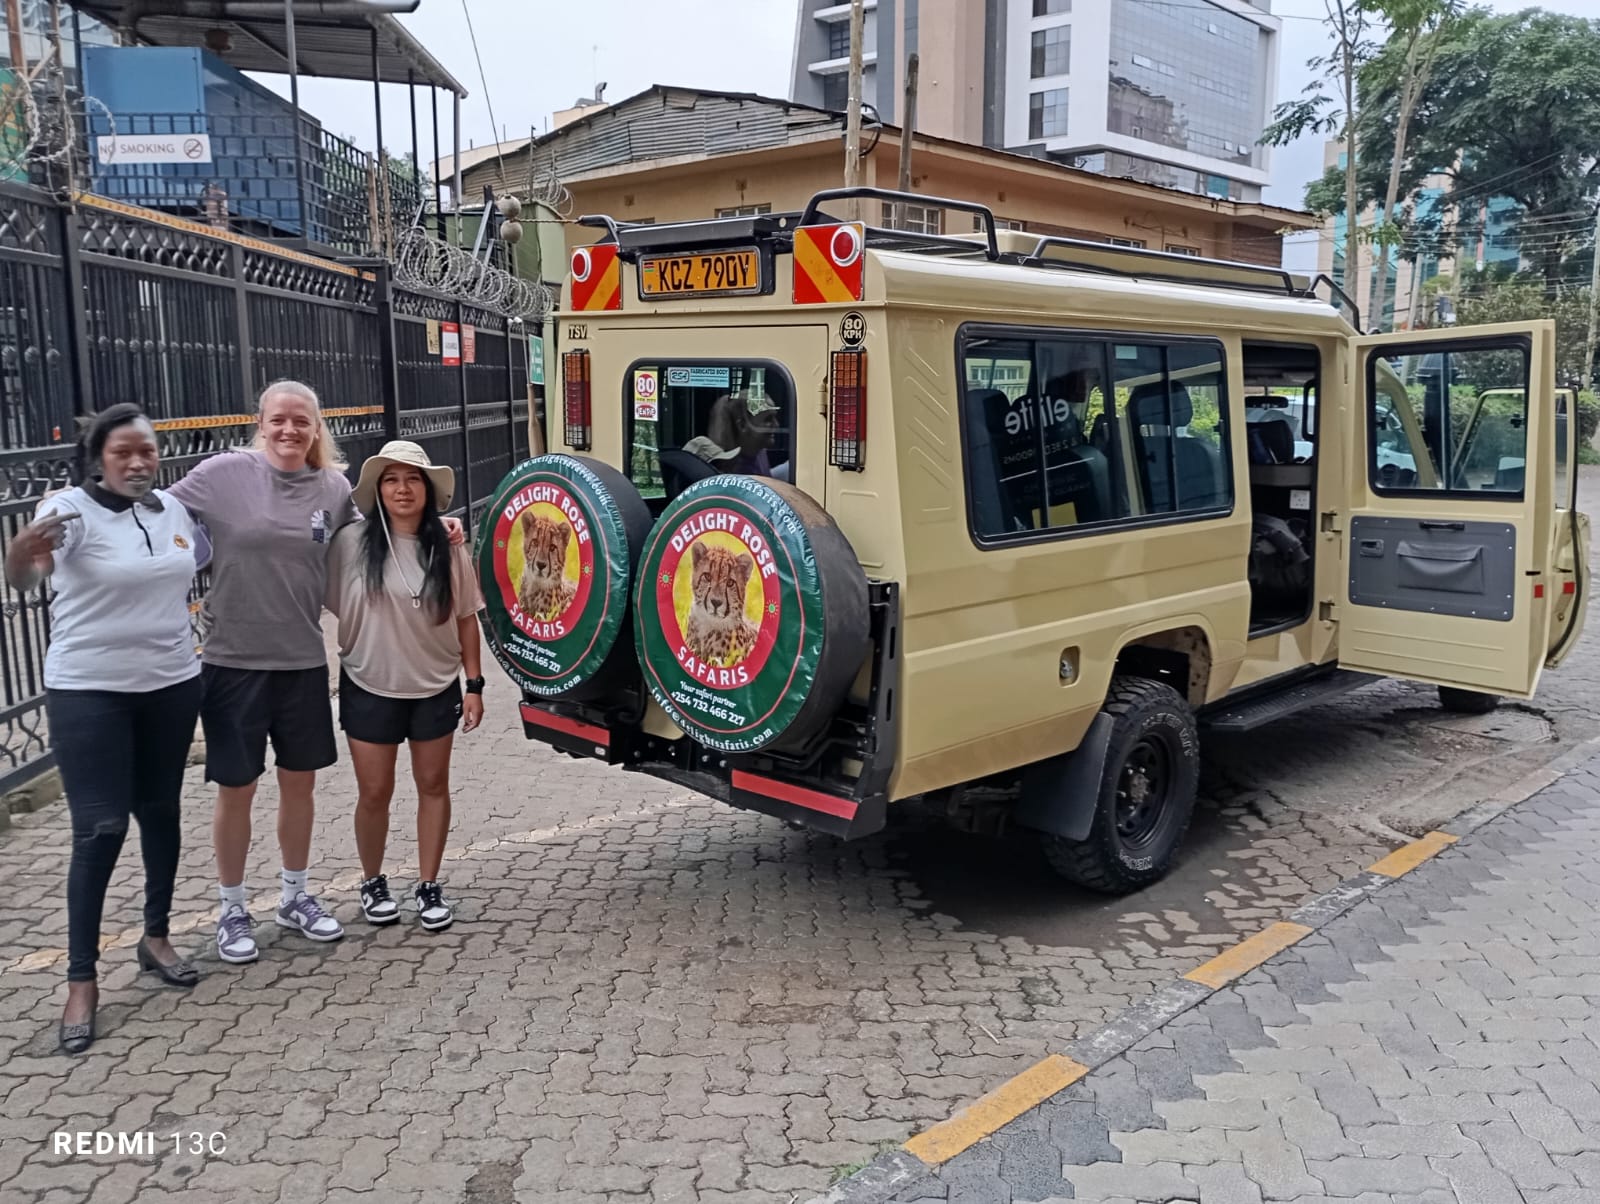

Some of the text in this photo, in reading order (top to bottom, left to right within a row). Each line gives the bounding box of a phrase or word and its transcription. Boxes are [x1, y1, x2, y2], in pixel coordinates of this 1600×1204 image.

[100, 143, 175, 155] NO SMOKING
[658, 254, 749, 291] KCZ 790Y
[569, 325, 587, 339] TSV
[843, 330, 862, 339] KPH
[844, 318, 863, 330] 80
[637, 377, 656, 393] 80
[504, 486, 590, 544] DELIGHT ROSE
[676, 475, 797, 535] www.delightsafaris.com
[671, 512, 776, 579] DELIGHT ROSE
[510, 603, 565, 638] SAFARIS
[677, 646, 748, 686] SAFARIS
[671, 691, 746, 726] +254 732 466 227
[680, 681, 737, 709] Your safari partner
[651, 687, 773, 750] info@delightsafaris.com
